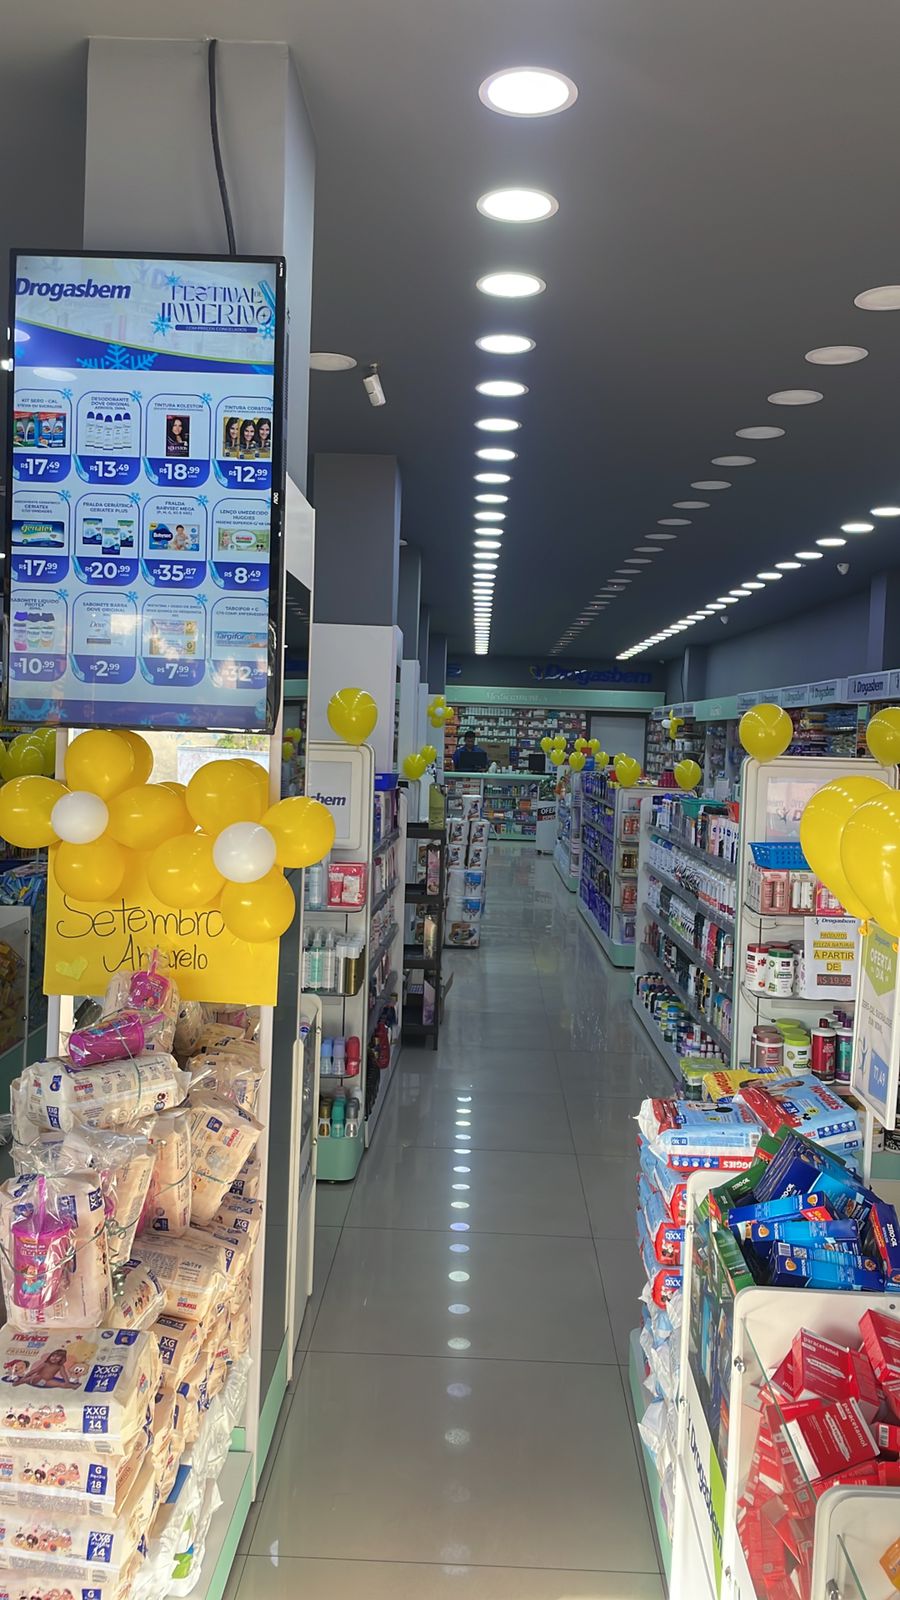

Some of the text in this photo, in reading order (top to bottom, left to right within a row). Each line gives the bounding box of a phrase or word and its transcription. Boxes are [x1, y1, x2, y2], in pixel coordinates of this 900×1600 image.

[16, 278, 131, 301] Drogasbem
[171, 285, 263, 304] FESTIVAL
[161, 302, 272, 325] INVERNO
[56, 893, 225, 938] Setembro
[822, 951, 854, 960] PARTIR
[803, 1337, 840, 1358] paracetamol
[95, 1366, 119, 1374] XXG
[95, 1379, 109, 1388] 14
[85, 1407, 107, 1415] XXG
[89, 1421, 102, 1430] 14
[842, 1402, 867, 1448] paracetamol
[95, 1466, 102, 1474] G
[91, 1480, 102, 1489] 18
[93, 1548, 105, 1557] 14
